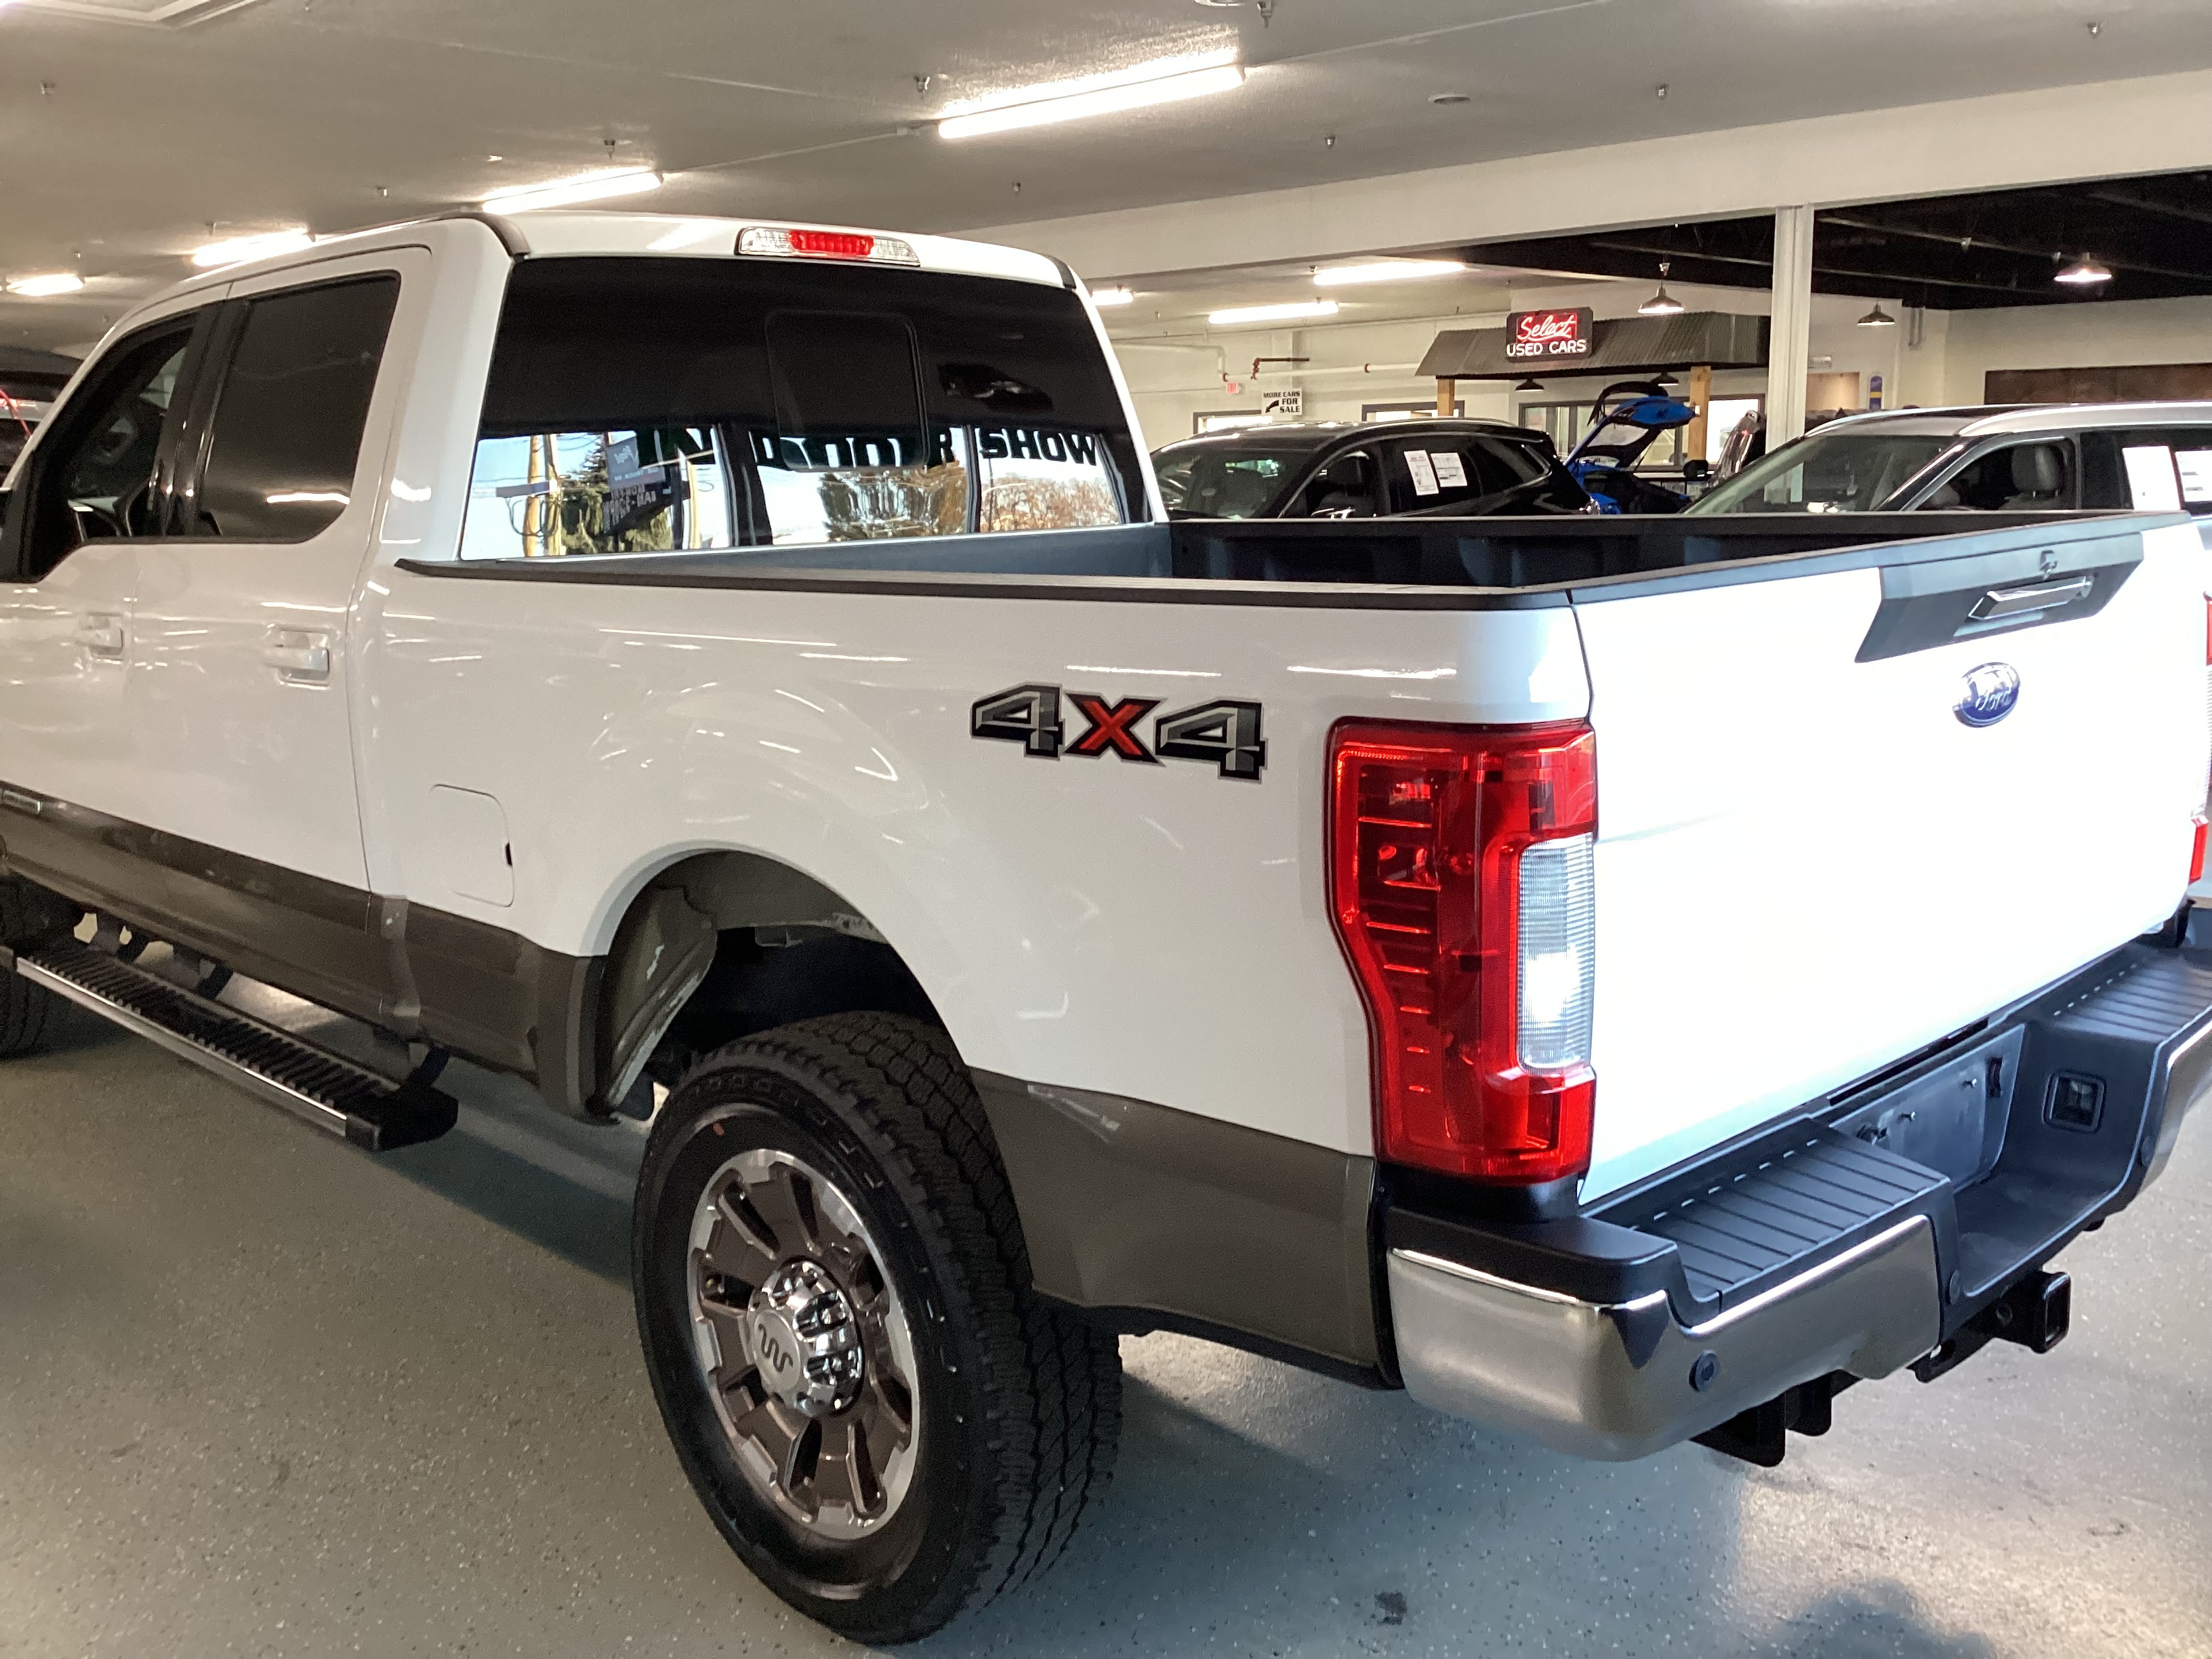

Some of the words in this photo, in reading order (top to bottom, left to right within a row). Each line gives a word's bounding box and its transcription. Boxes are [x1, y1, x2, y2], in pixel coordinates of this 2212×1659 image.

[1517, 314, 1576, 341] Select
[1506, 342, 1543, 356] USED
[1549, 339, 1586, 354] CARS
[980, 428, 1097, 466] SHOW
